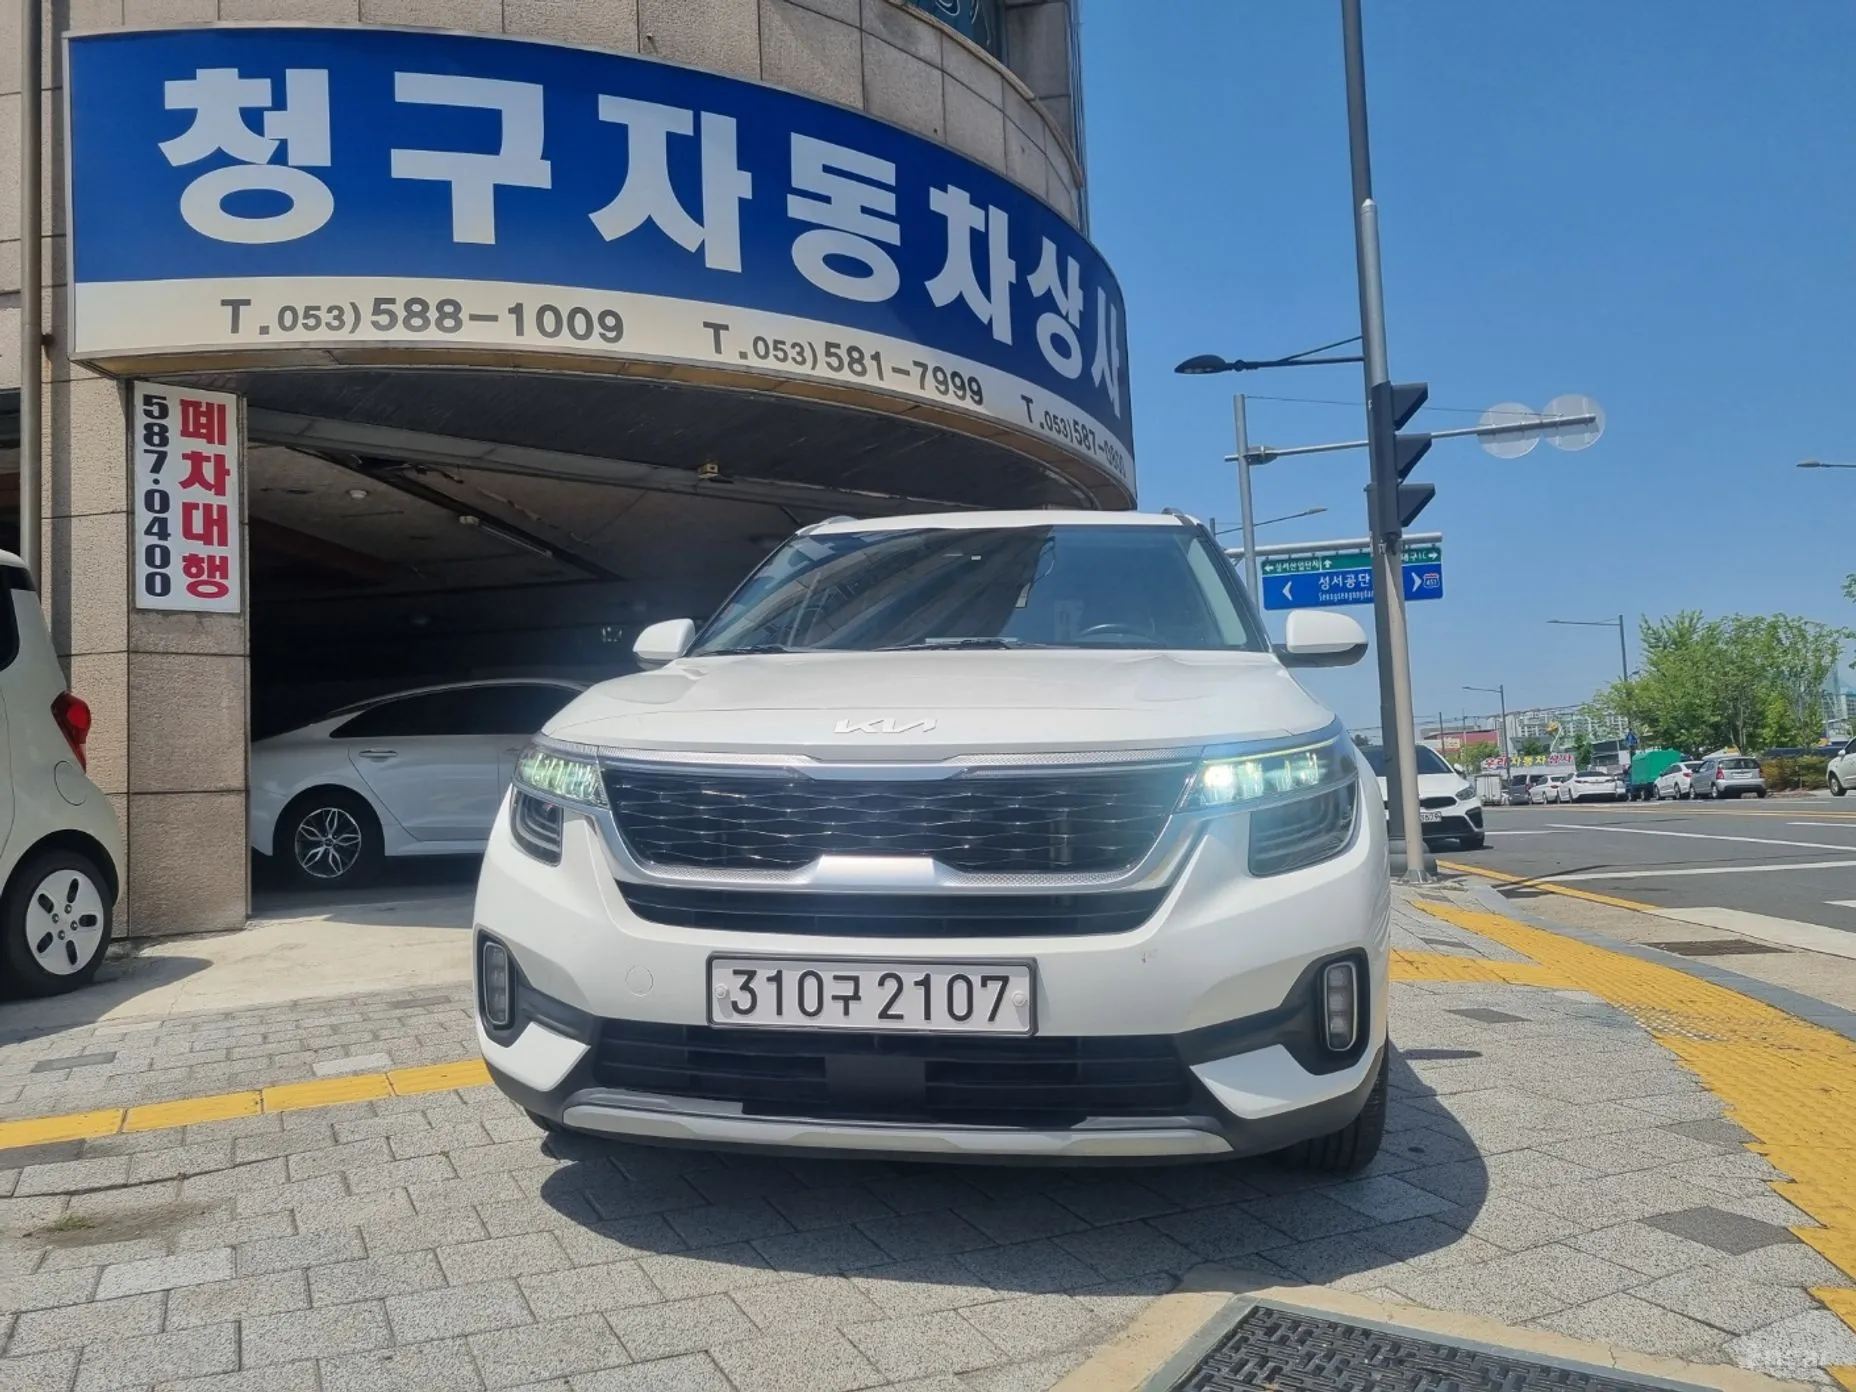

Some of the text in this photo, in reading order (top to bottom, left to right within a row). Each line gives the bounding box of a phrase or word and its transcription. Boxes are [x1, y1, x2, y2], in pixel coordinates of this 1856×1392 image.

[179, 398, 231, 600] 폐차대행
[1318, 573, 1370, 590] 성서공단
[834, 718, 939, 733] KIA
